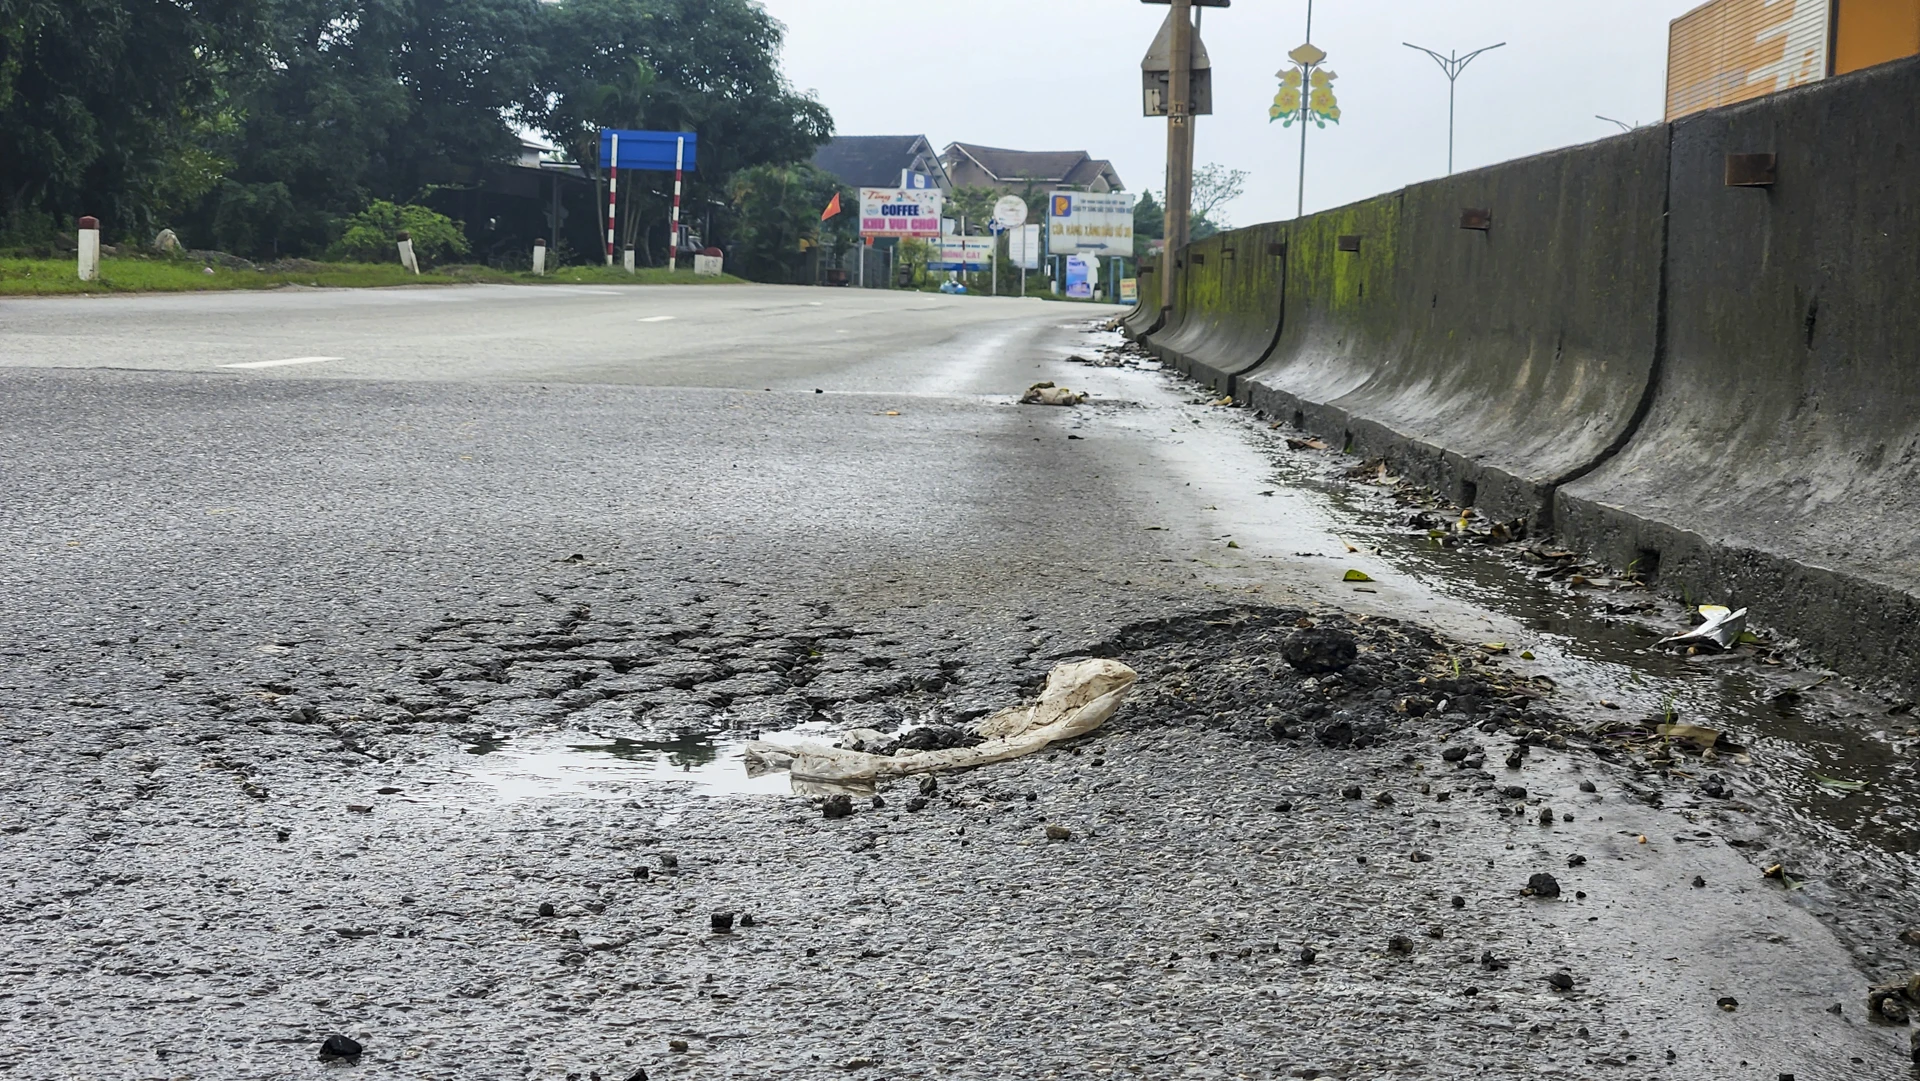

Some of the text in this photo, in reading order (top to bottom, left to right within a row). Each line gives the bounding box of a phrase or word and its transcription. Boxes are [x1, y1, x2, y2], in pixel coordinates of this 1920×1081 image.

[881, 204, 919, 216] COFFEE
[863, 218, 886, 230] KHU
[888, 218, 908, 230] VUI
